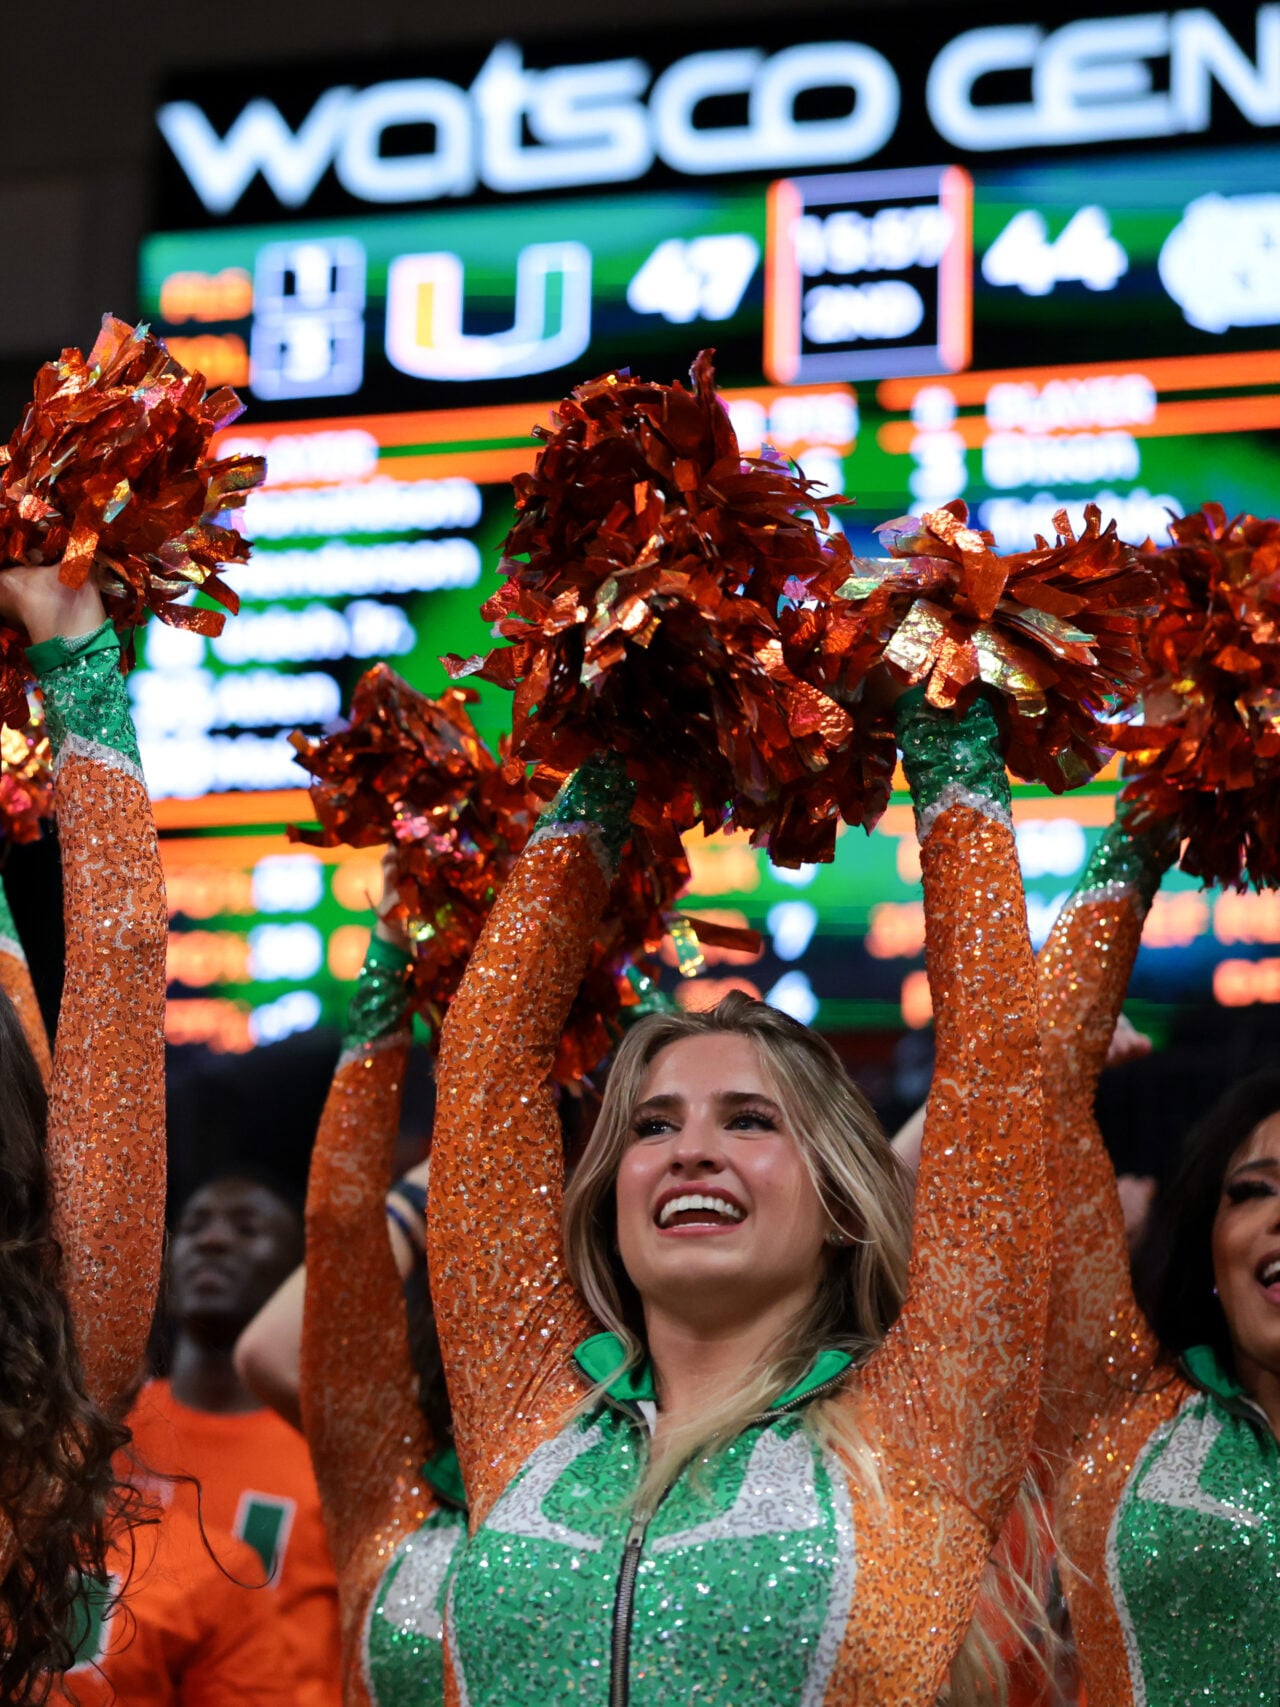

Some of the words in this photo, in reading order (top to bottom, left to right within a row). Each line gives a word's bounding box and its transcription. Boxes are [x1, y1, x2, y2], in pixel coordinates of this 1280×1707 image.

[627, 233, 759, 323] 47
[981, 205, 1128, 296] 44
[386, 241, 591, 380] U
[803, 280, 924, 344] 2ND
